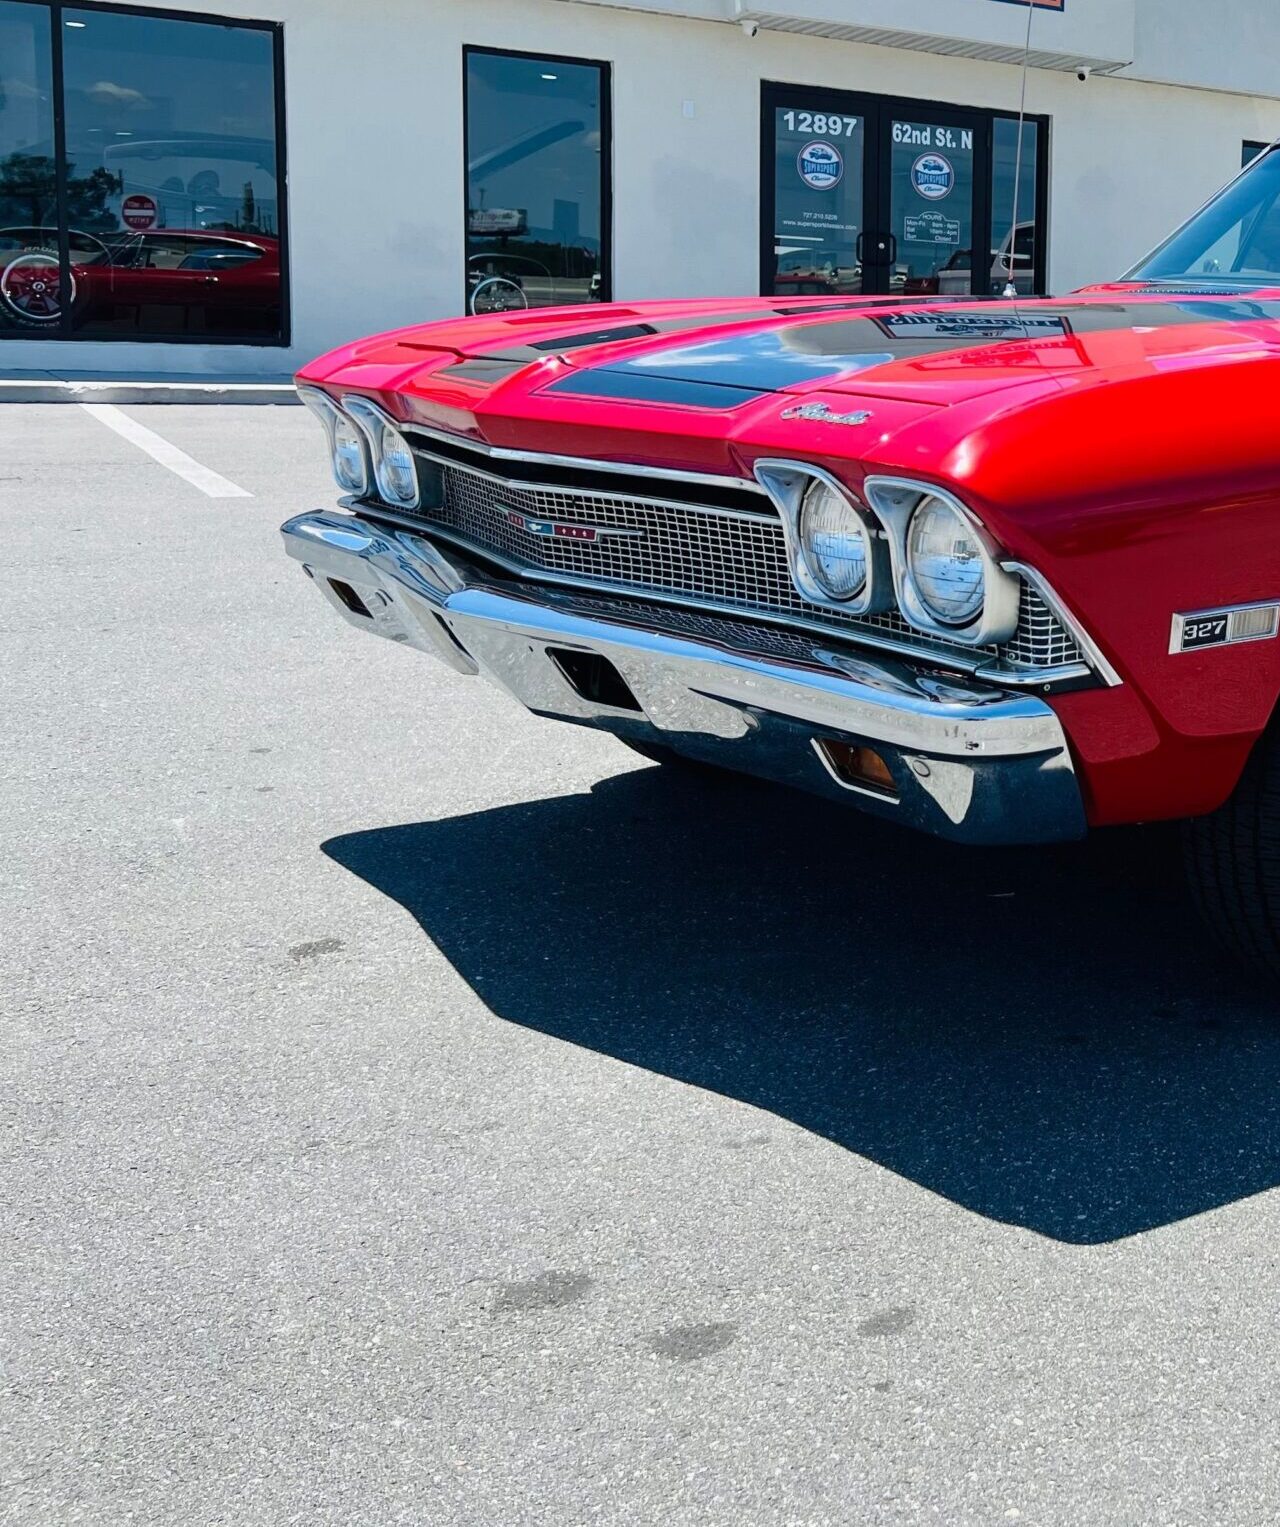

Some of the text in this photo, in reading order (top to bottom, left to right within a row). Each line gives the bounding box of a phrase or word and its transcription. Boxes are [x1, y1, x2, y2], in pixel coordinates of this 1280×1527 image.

[783, 111, 857, 137] 12897
[892, 123, 973, 149] 62nd St. N
[804, 160, 836, 175] SUPERSPORT
[917, 171, 948, 186] SUPERSPORT
[1184, 620, 1226, 640] 327
